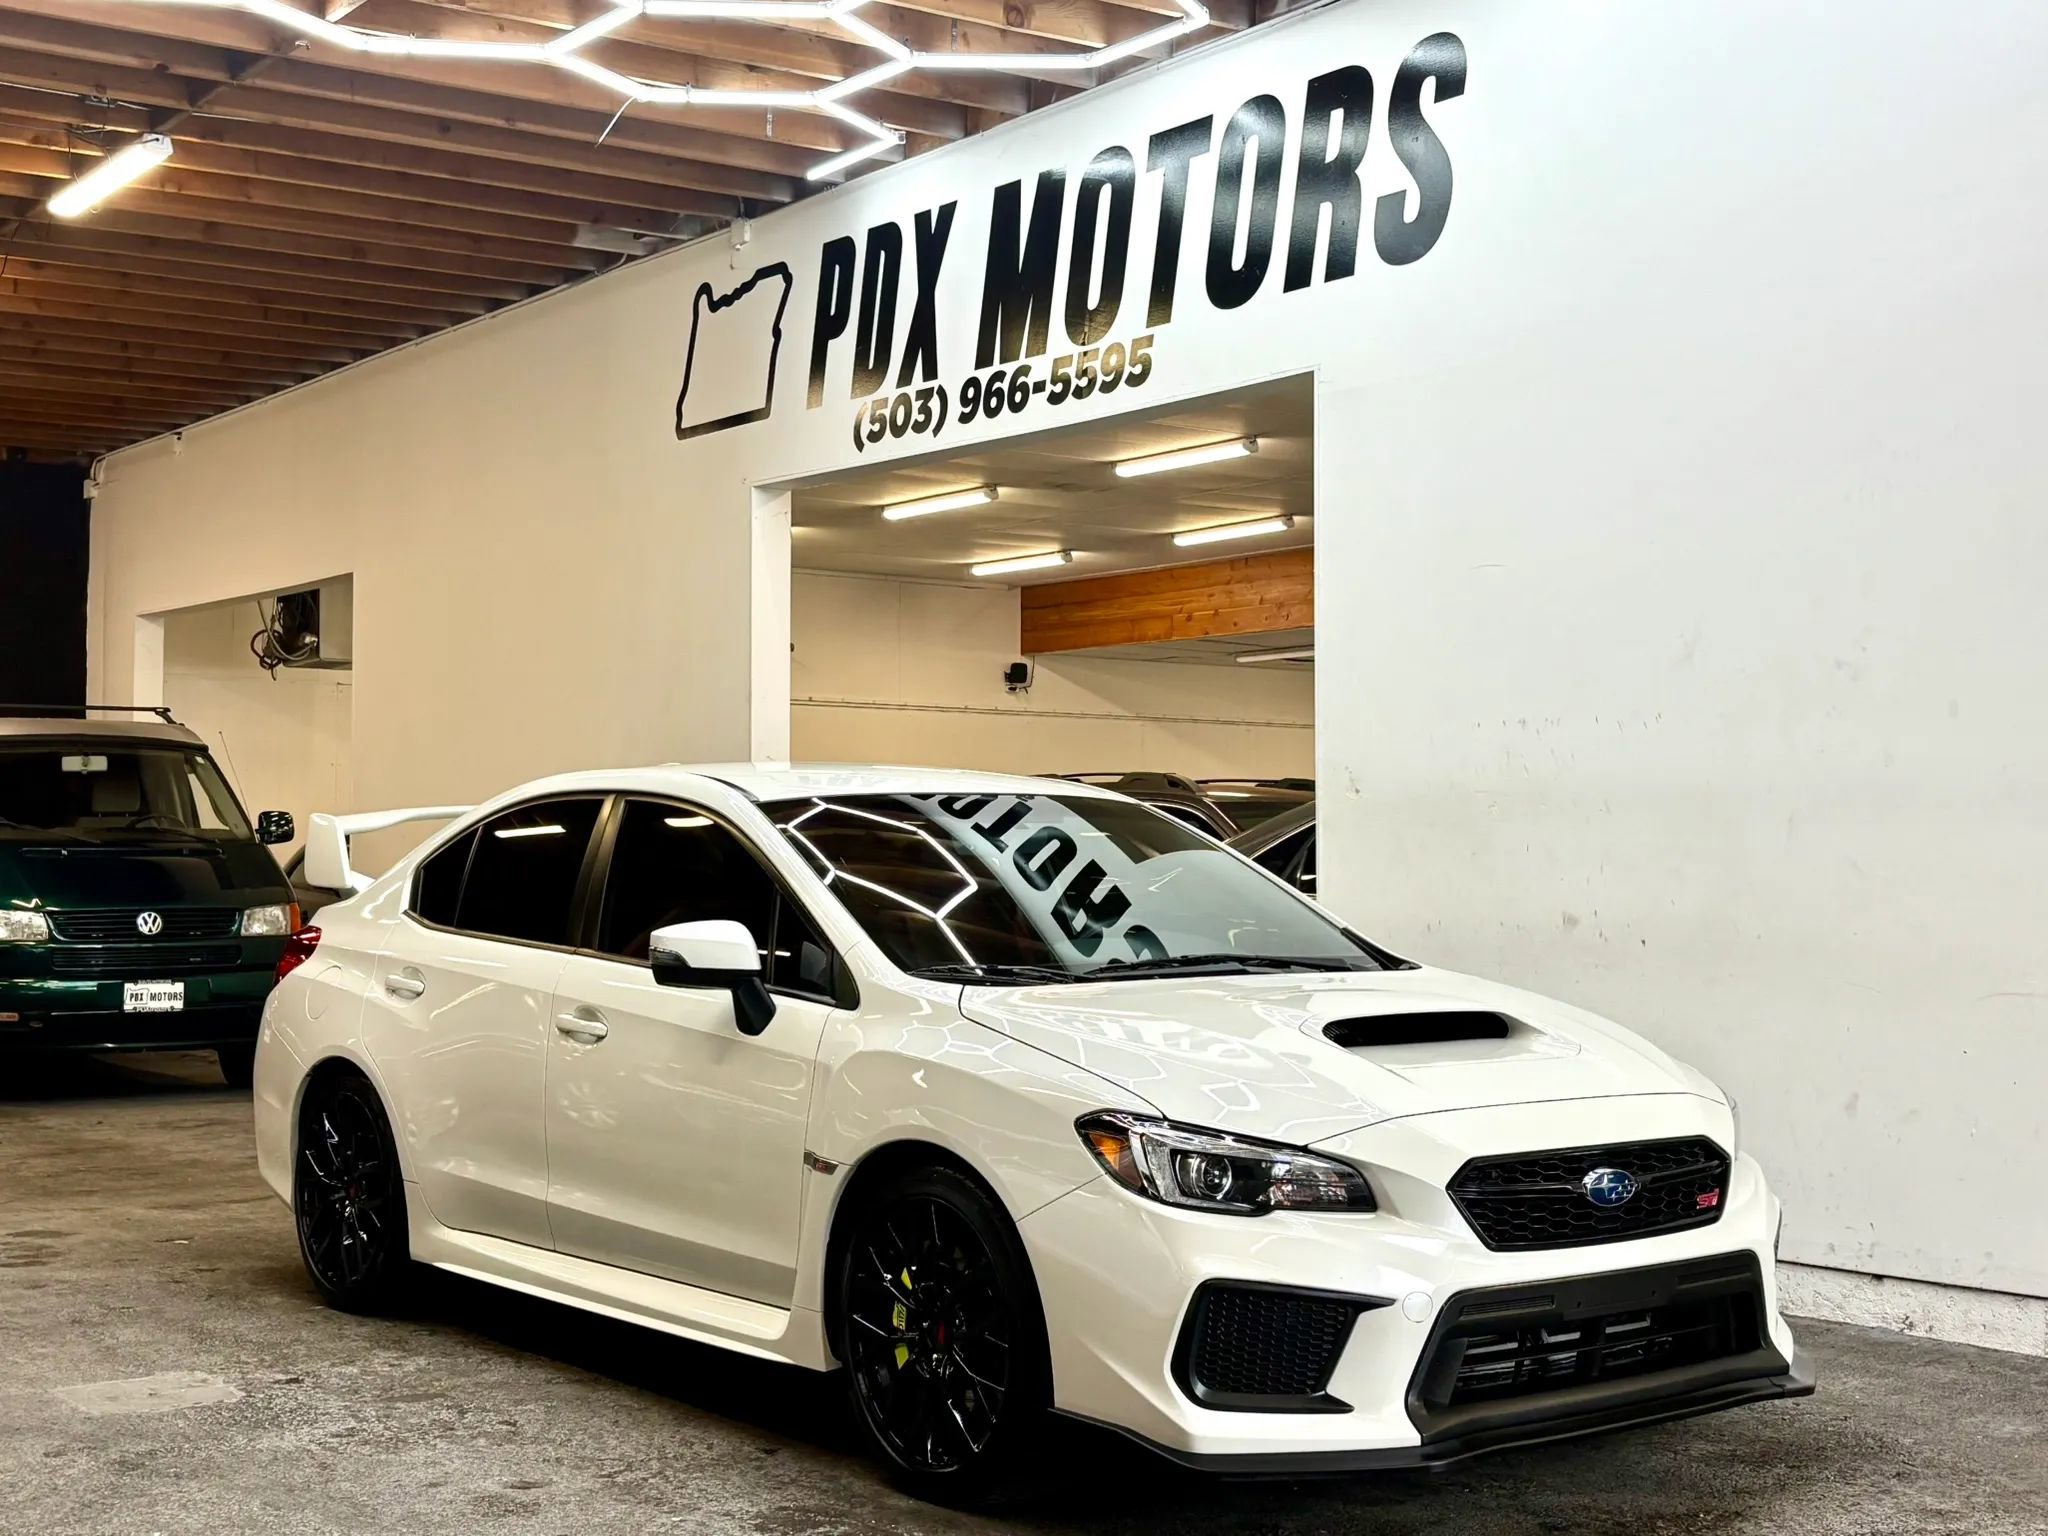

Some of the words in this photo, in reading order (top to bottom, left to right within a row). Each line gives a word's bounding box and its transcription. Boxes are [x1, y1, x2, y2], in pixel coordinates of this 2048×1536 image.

[806, 200, 957, 410] PDX
[974, 31, 1468, 371] MOTORS
[853, 383, 948, 453] (503)
[957, 334, 1155, 425] 966-5595
[149, 991, 183, 1002] MOTORS
